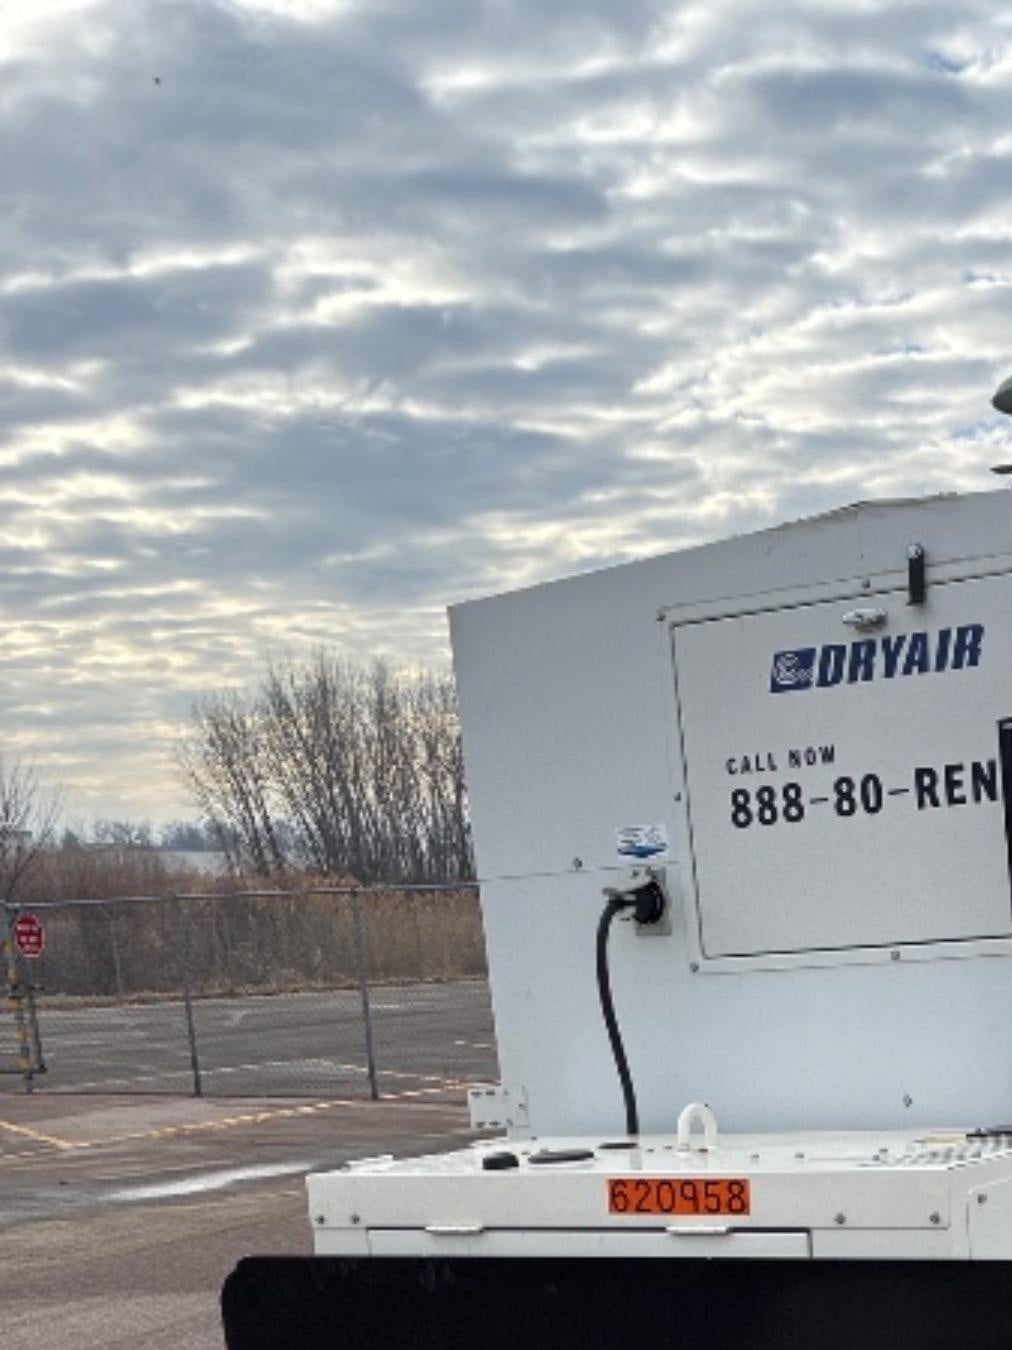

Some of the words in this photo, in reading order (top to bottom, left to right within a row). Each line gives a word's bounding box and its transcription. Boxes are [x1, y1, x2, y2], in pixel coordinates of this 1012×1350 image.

[816, 623, 985, 688] DRYAIR
[726, 752, 777, 775] CALL
[788, 744, 836, 768] NOW
[731, 759, 999, 829] 888-80-REN
[610, 1180, 748, 1213] 620958
